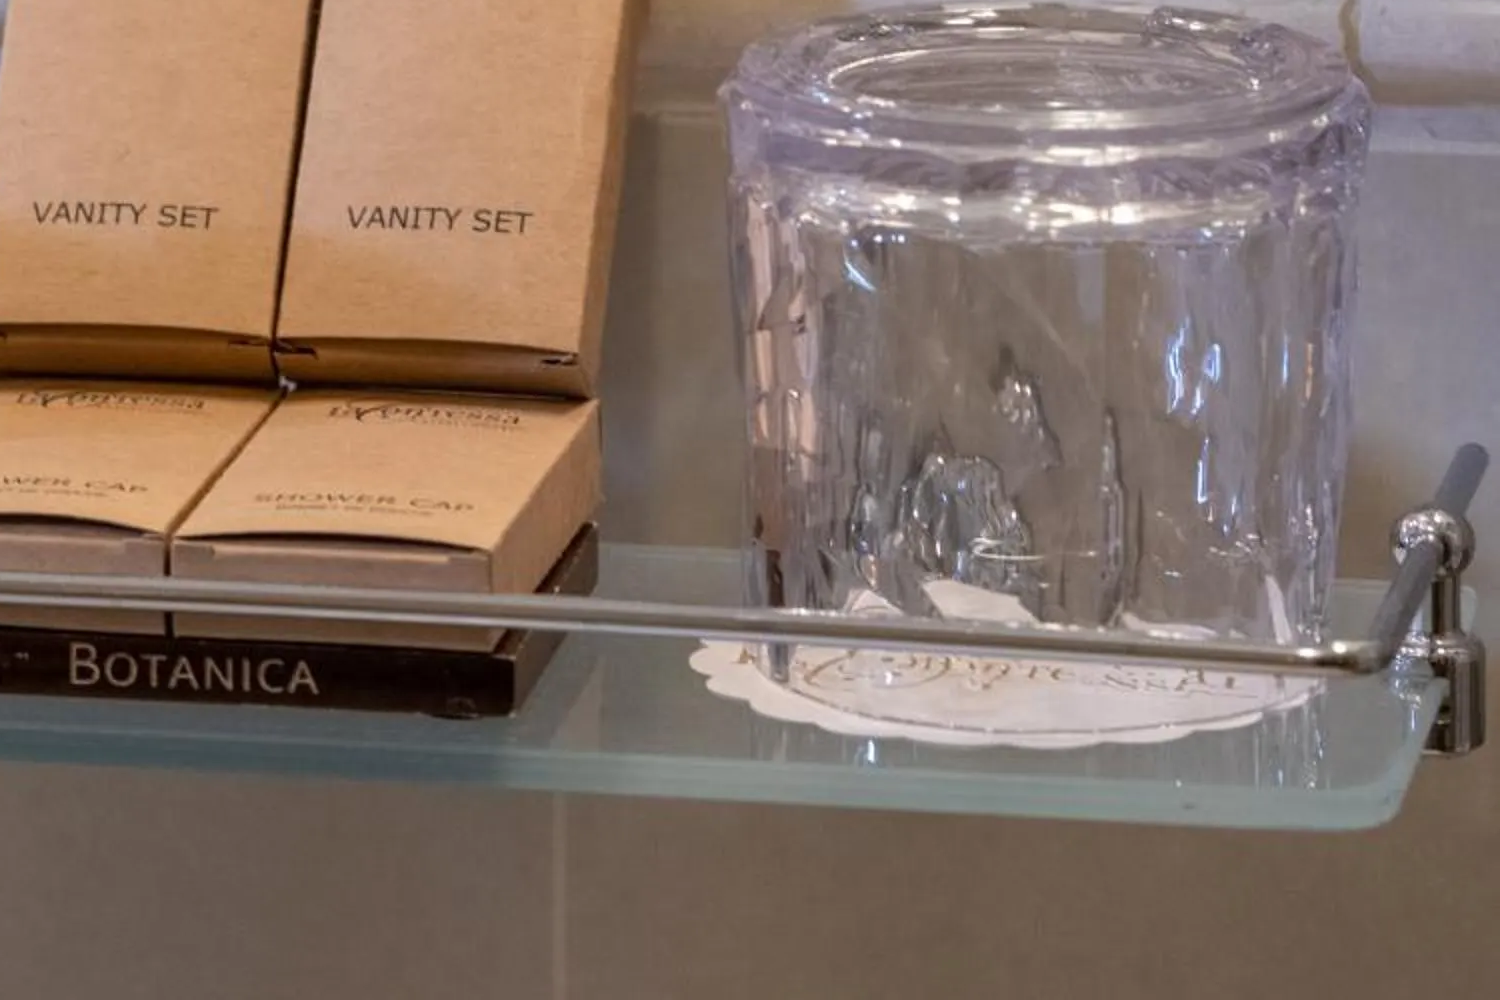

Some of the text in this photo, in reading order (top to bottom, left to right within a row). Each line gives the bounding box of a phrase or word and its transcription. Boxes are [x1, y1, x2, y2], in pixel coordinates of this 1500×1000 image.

[33, 201, 220, 230] VANITY SET
[347, 204, 535, 235] VANITY SET
[68, 641, 320, 696] BOTANICA
